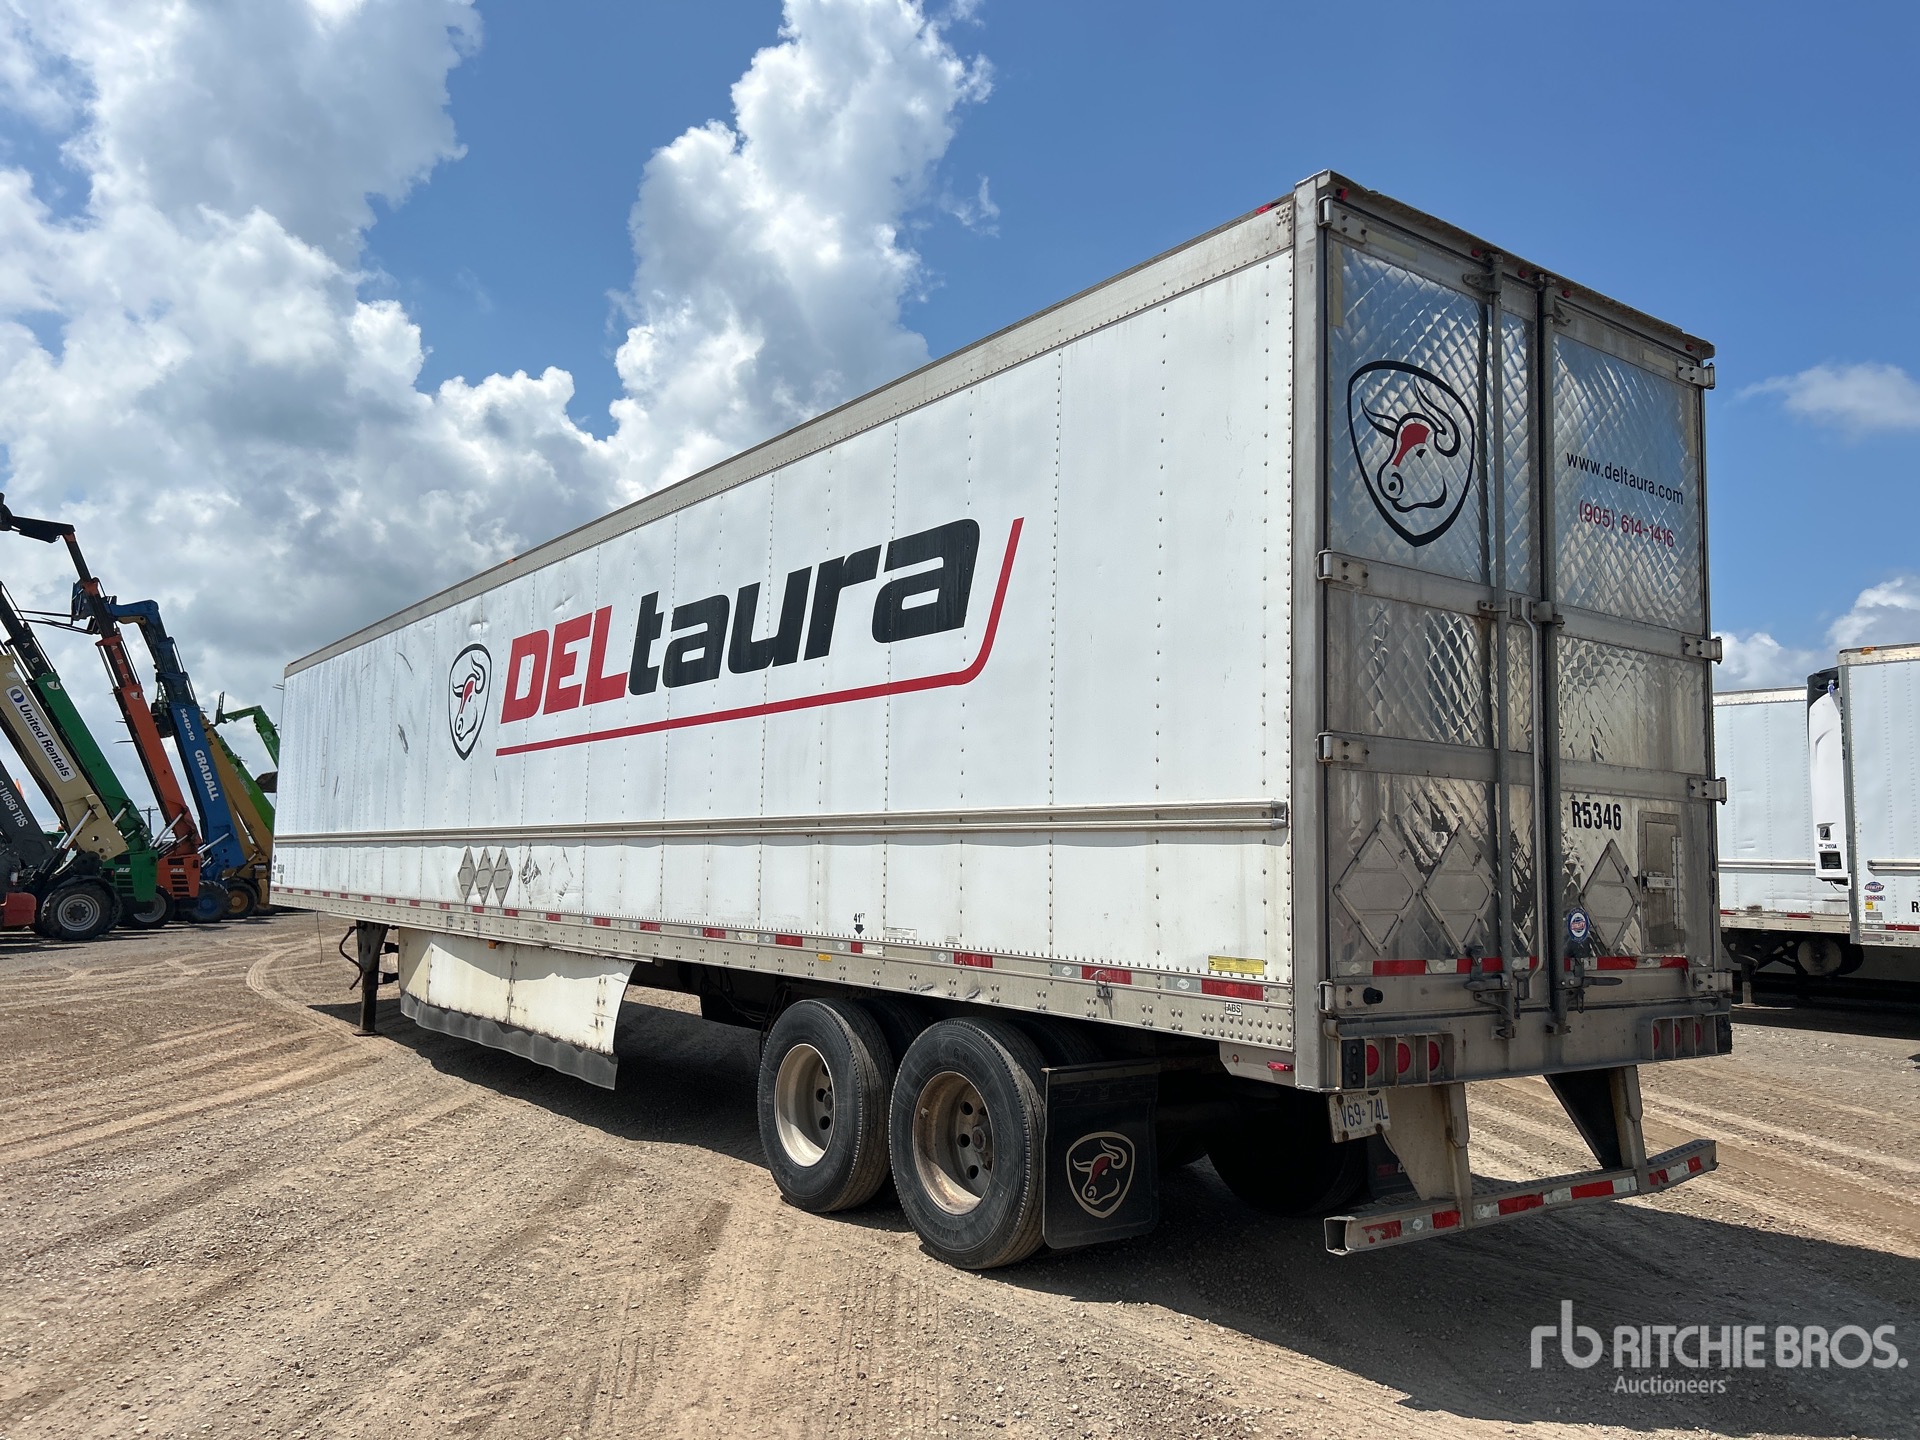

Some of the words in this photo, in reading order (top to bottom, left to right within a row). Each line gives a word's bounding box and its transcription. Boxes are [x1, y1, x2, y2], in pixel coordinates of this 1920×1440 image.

[1566, 452, 1684, 505] www.deltaura.com
[1579, 500, 1615, 531] (905)
[1621, 514, 1674, 548] 614-1416
[500, 518, 980, 724] DELtaura
[19, 703, 47, 743] United
[39, 738, 71, 777] Rentals
[194, 749, 221, 802] GRADALL
[12, 809, 29, 828] THS
[1571, 800, 1622, 831] R5346
[1227, 1003, 1241, 1013] ABS
